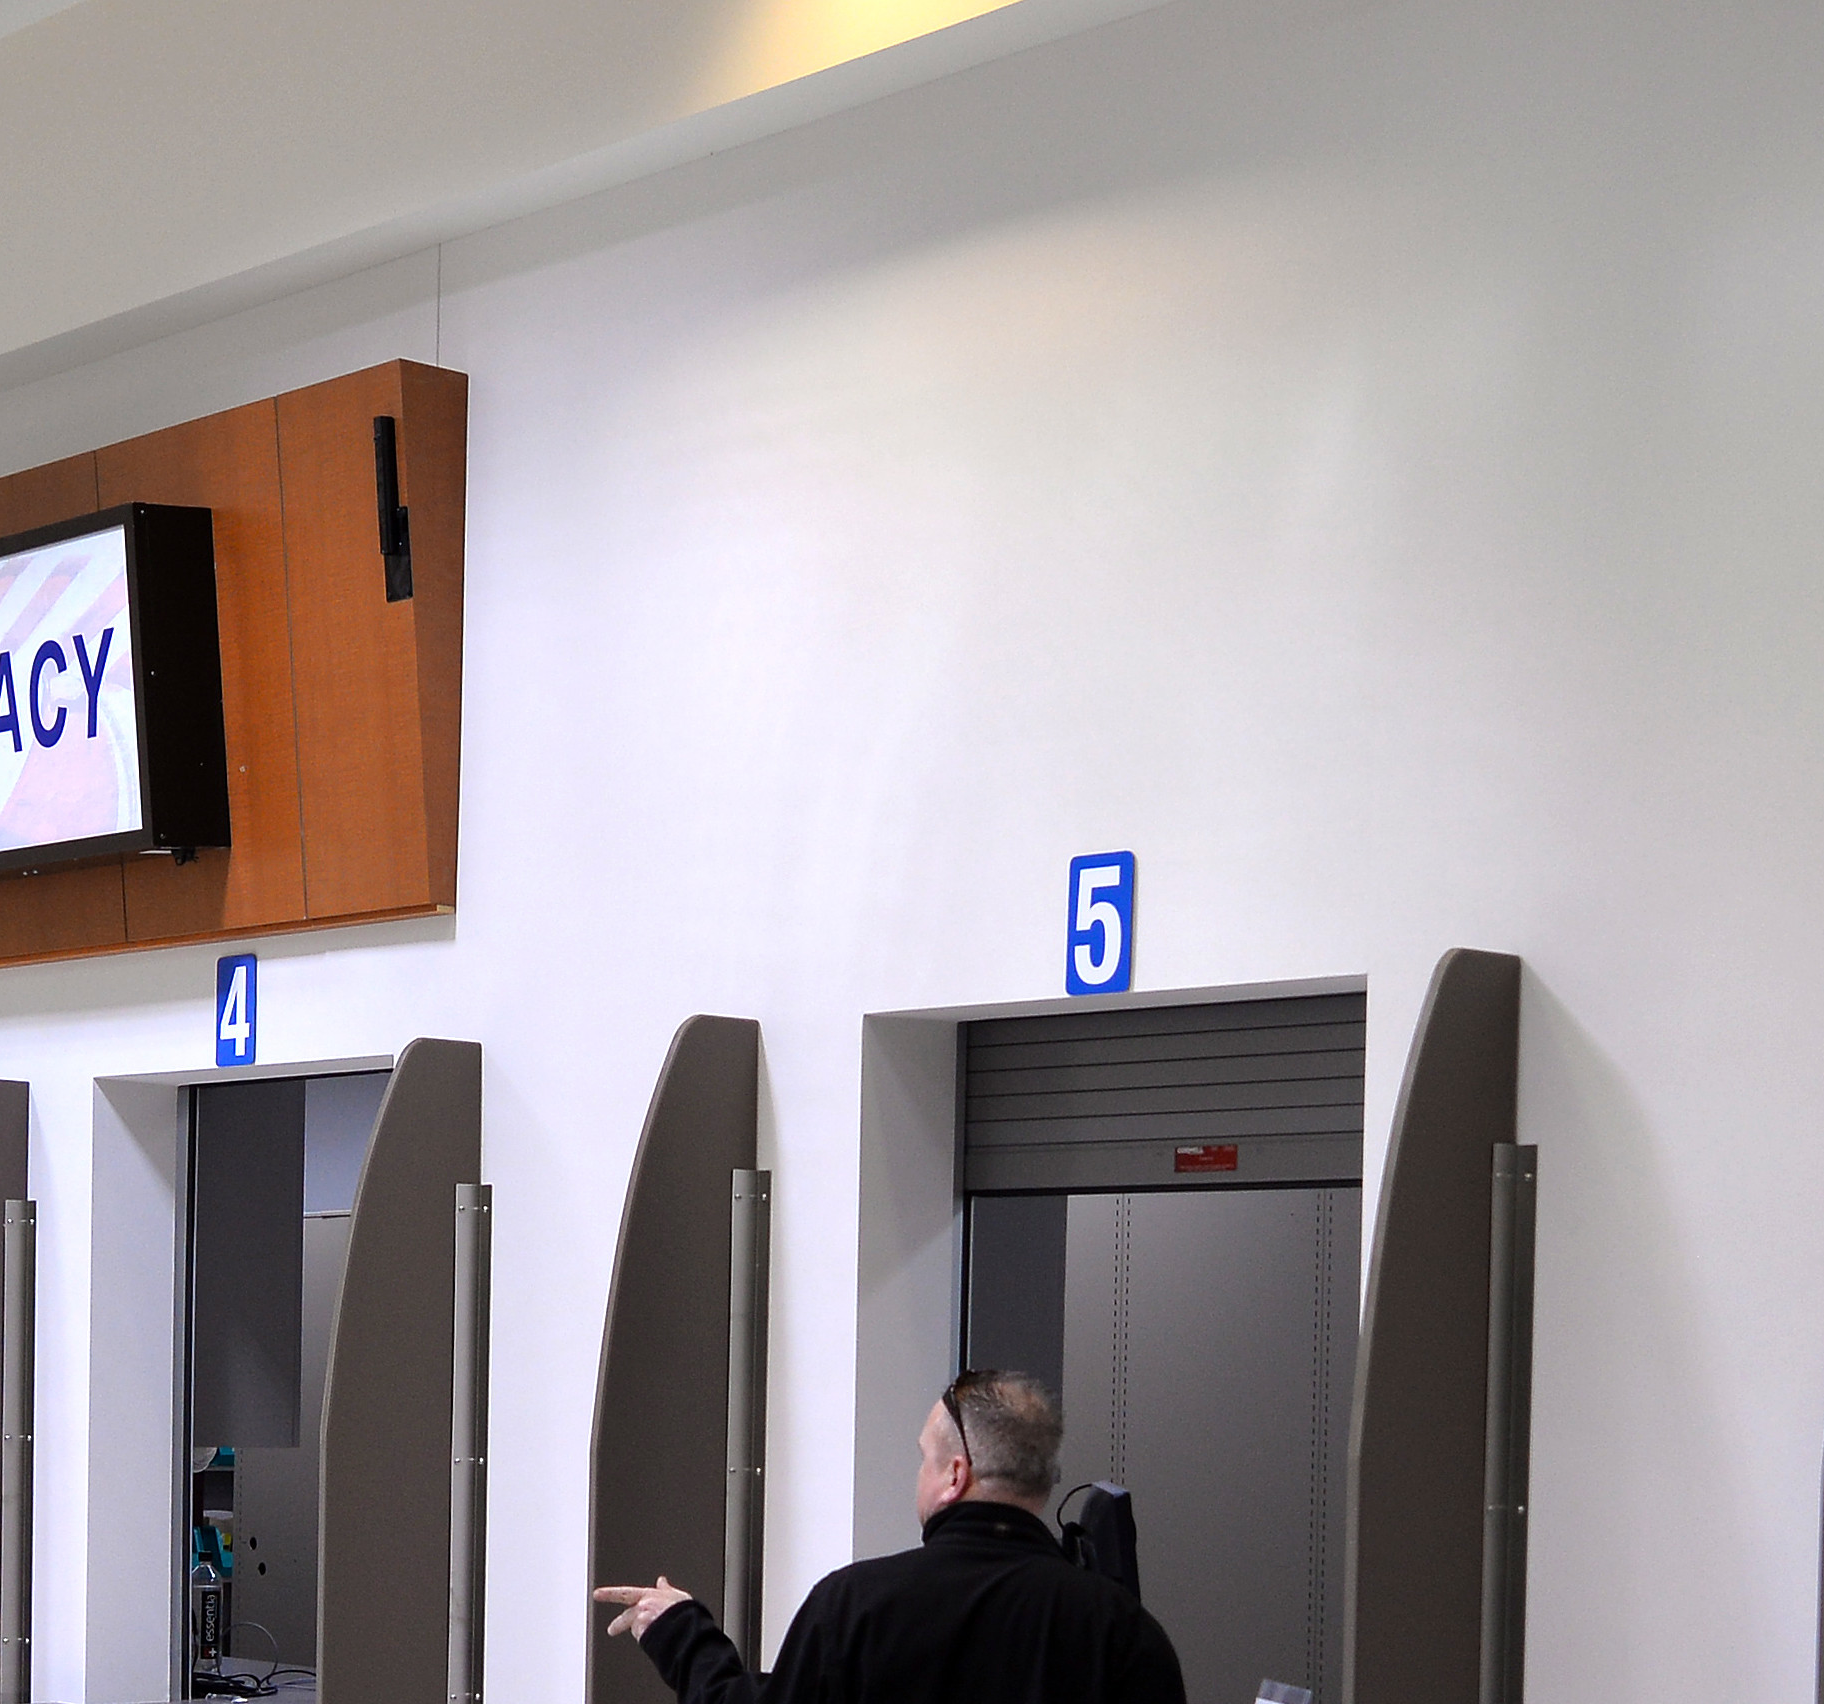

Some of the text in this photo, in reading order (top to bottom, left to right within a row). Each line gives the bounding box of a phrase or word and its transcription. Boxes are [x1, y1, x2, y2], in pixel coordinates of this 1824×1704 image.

[1074, 865, 1121, 984] 5
[220, 966, 250, 1056] 4
[205, 1594, 216, 1642] essentia
